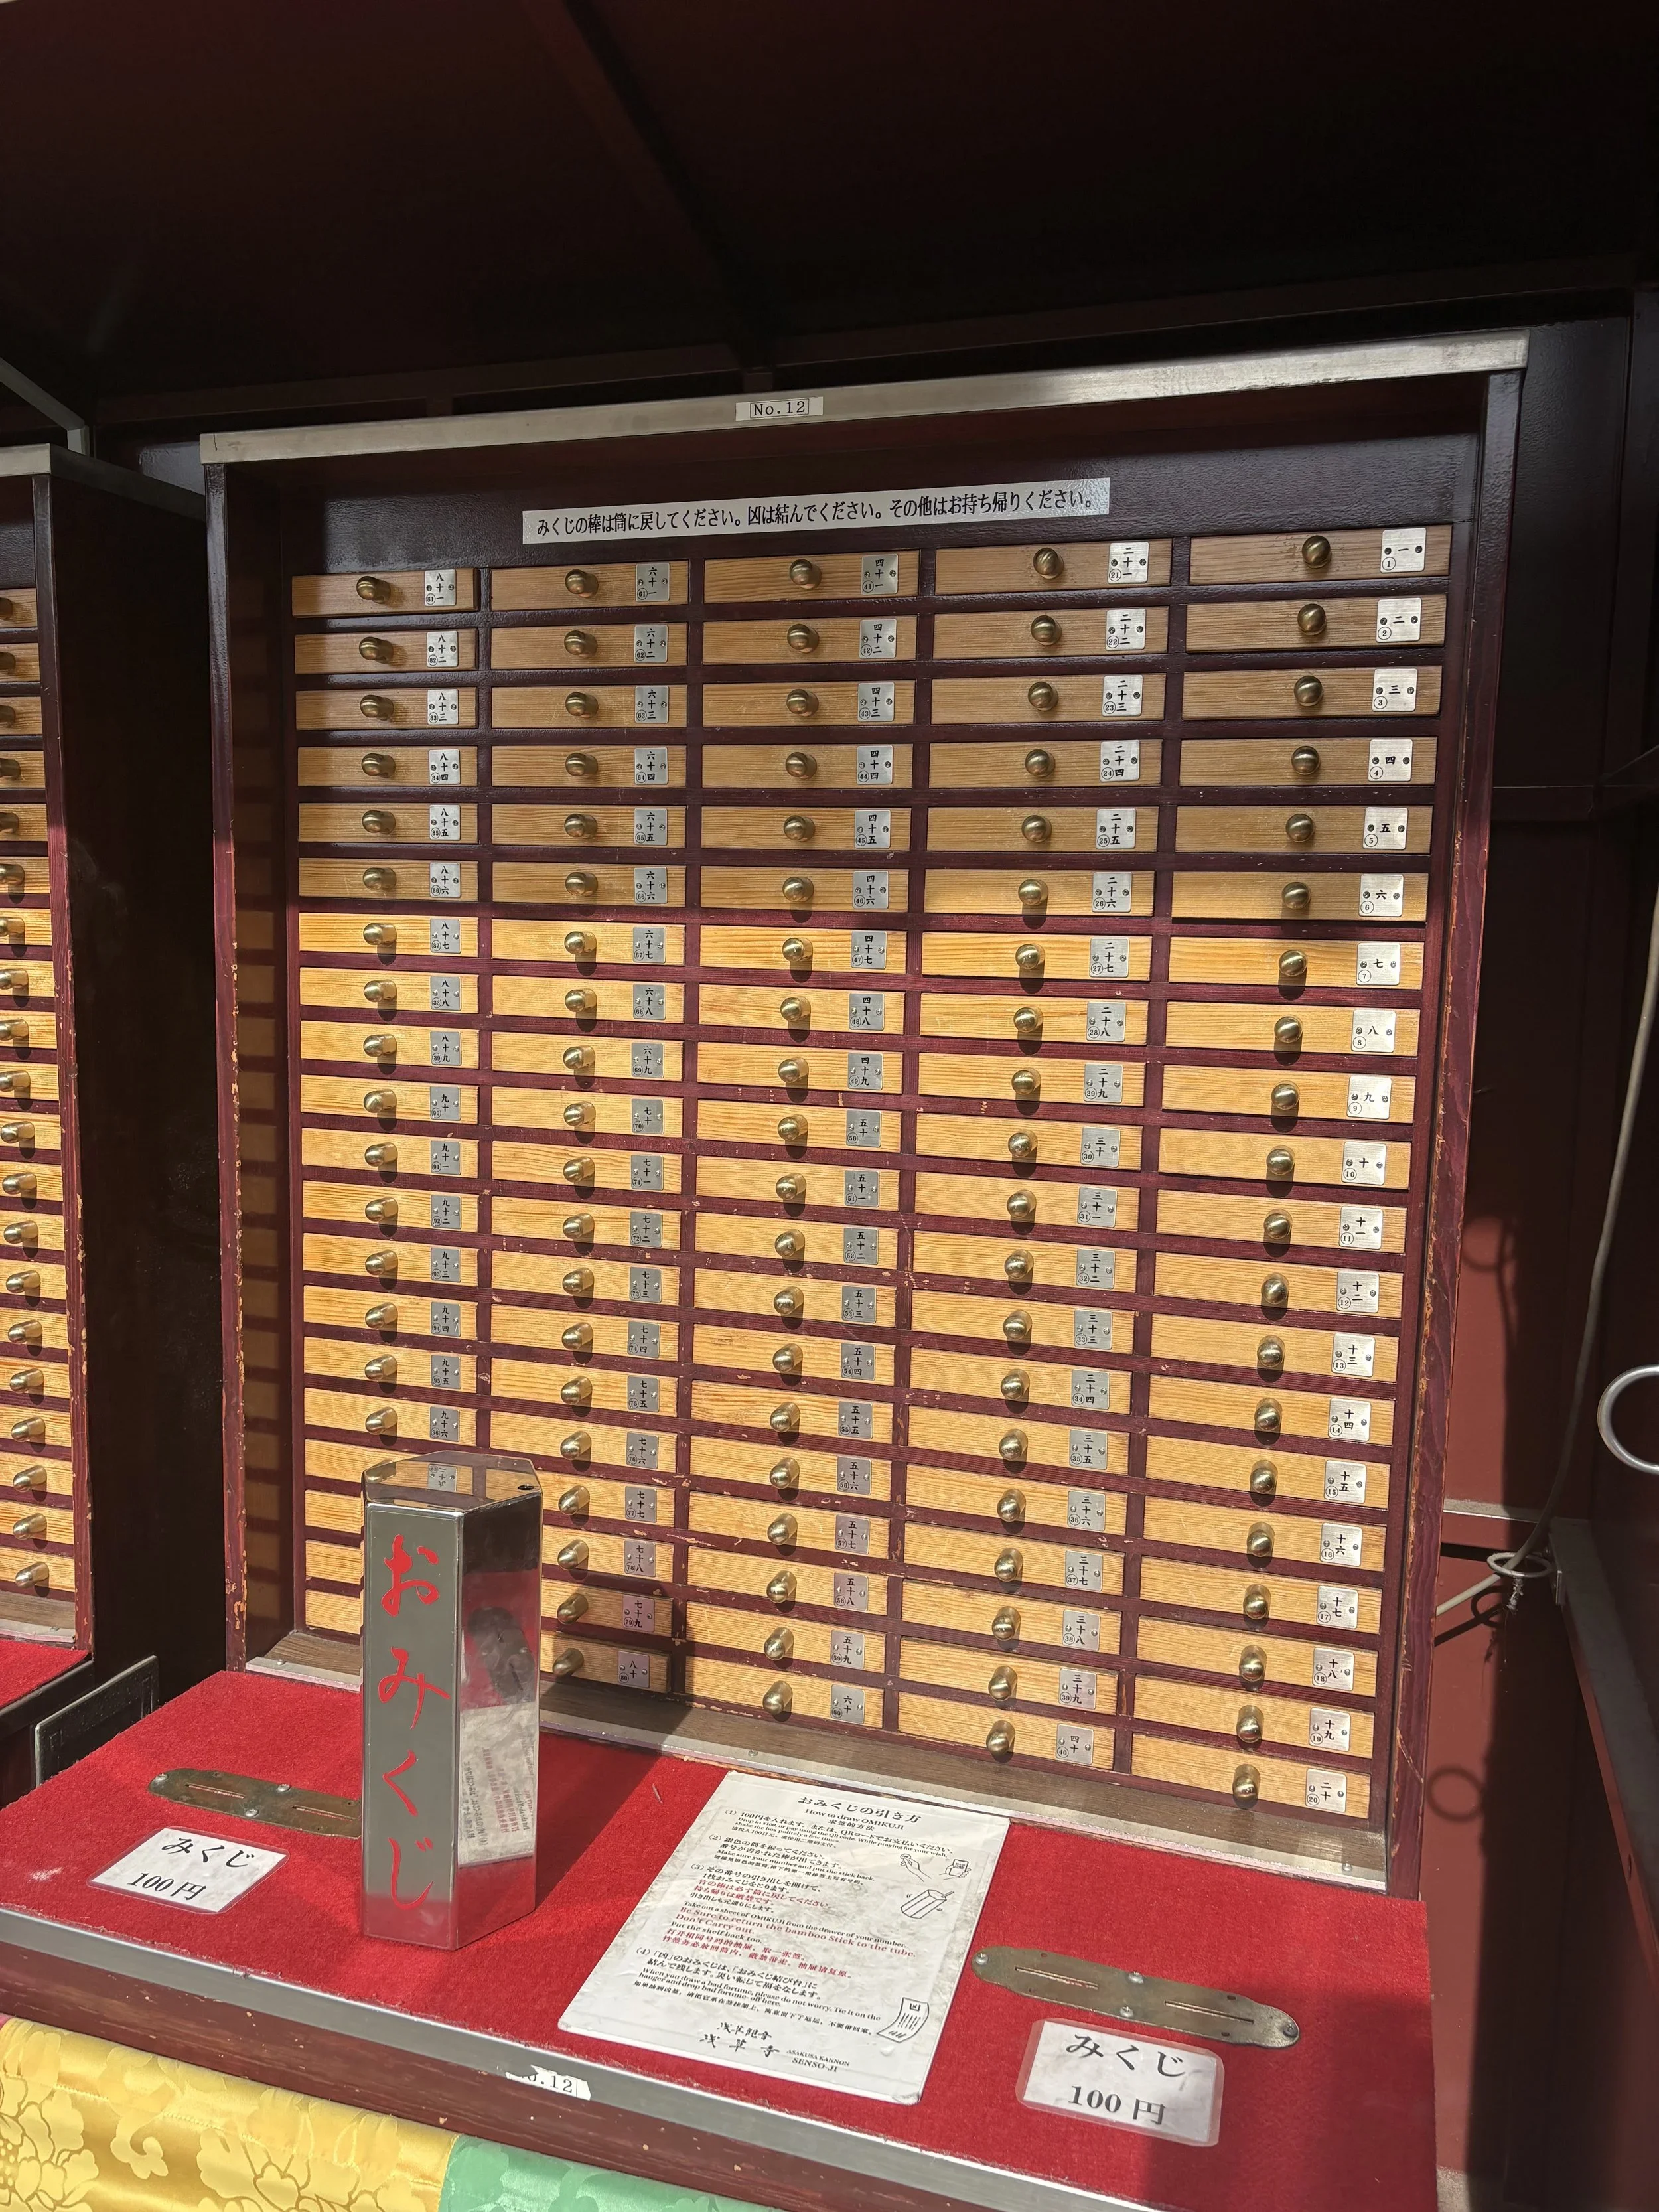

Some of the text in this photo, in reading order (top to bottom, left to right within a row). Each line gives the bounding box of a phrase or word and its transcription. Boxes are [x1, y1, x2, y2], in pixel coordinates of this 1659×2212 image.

[753, 400, 806, 416] No.12
[646, 628, 656, 658] 六十二
[872, 623, 883, 654] 四十二
[1119, 613, 1131, 645] 二十二
[437, 634, 447, 664] 八十二
[1388, 684, 1401, 695] 三
[438, 692, 447, 721] 八十三
[647, 689, 657, 719] 六十三
[869, 749, 879, 780] 四十四
[440, 808, 449, 837] 八十五
[646, 812, 656, 842] 六十五
[867, 814, 877, 844] 四十五
[1110, 814, 1121, 845] 二十五
[1379, 823, 1392, 833] 五
[1375, 889, 1387, 900] 六
[863, 935, 874, 964] 四十七
[1104, 942, 1116, 973] 二十七
[440, 979, 450, 1007] 八十八
[645, 987, 654, 1016] 六十八
[1367, 1025, 1379, 1035] 八
[644, 1106, 652, 1126] 七十
[859, 1118, 869, 1138] 五十
[441, 1143, 450, 1168] 九十一
[1095, 1137, 1106, 1157] 三十
[1358, 1157, 1369, 1169] 十
[442, 1198, 451, 1224] 九十二
[642, 1215, 650, 1242] 七十二
[1355, 1217, 1366, 1234] 十一
[854, 1290, 864, 1319] 五十三
[1352, 1280, 1363, 1301] 十二
[1087, 1314, 1098, 1344] 三十三
[639, 1380, 648, 1408] 七十五
[1082, 1434, 1094, 1465] 三十五
[847, 1520, 857, 1549] 五十七
[1334, 1534, 1346, 1556] 十六
[636, 1544, 644, 1572] 七十八
[1075, 1615, 1086, 1645] 三十八
[1072, 1674, 1083, 1704] 三十九
[843, 1695, 853, 1714] 六十
[378, 1534, 450, 1910] おみくじ
[1323, 1719, 1335, 1741] 十九
[798, 1797, 922, 1823] おみくじの引き方
[861, 1819, 904, 1830] OMIKUJI
[161, 1837, 255, 1868] みくじ
[676, 1914, 706, 1923] Don't
[705, 1919, 734, 1931] Carry
[693, 1909, 717, 1919] Sure
[731, 1917, 762, 1927] return
[785, 1927, 826, 1939] bamboo
[828, 1935, 854, 1945] Stick
[890, 1948, 915, 1957] tube.
[724, 1931, 745, 1940] back
[751, 1914, 785, 1925] OMIKUJI
[818, 1927, 845, 1936] drawer
[874, 1937, 906, 1948] number.
[638, 1972, 668, 1982] hanger
[682, 1980, 700, 1990] drop
[762, 1996, 783, 2007] here.
[641, 1968, 664, 1976] When
[680, 1975, 701, 1984] draw
[721, 1984, 753, 1996] fortune,
[755, 1991, 780, 2000] please
[808, 2002, 832, 2012] worry.
[786, 2049, 849, 2066] ASAKUSA KANNON
[792, 2057, 837, 2072] SENSO-JI
[1066, 2034, 1185, 2077] みくじ
[520, 2073, 572, 2093] o.12
